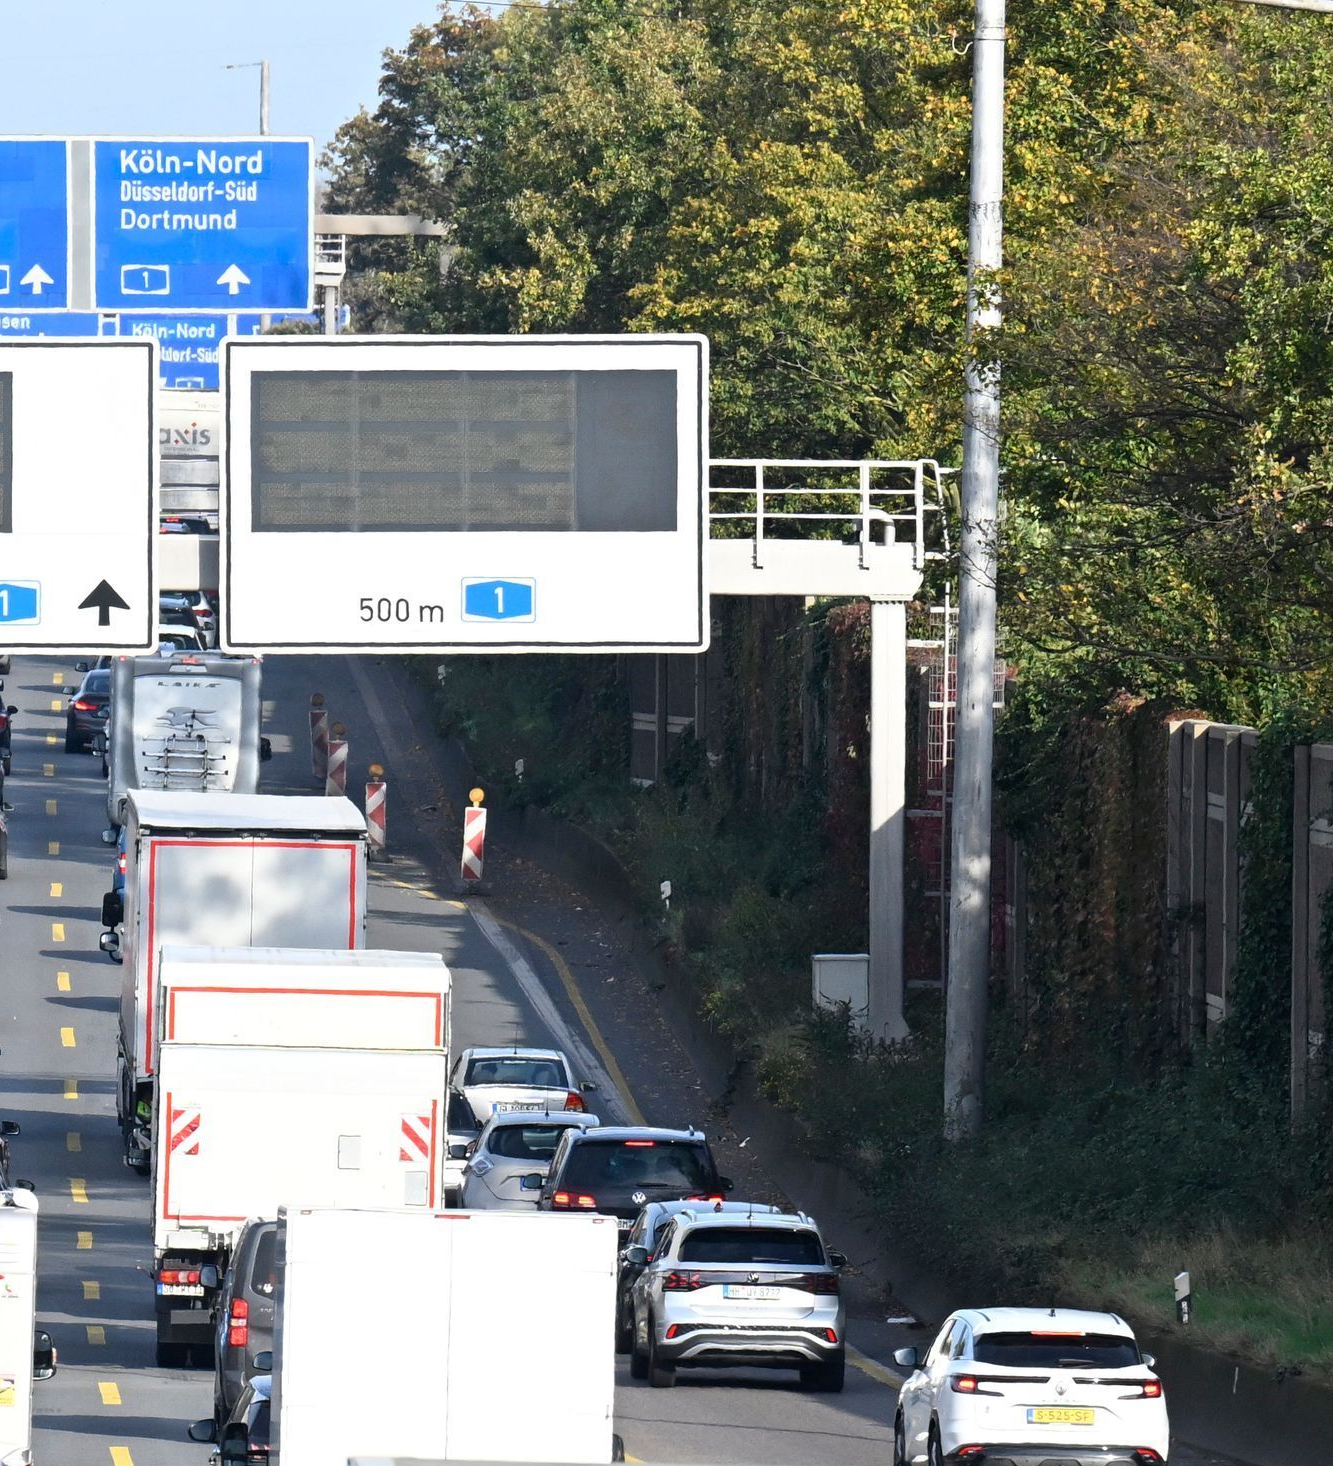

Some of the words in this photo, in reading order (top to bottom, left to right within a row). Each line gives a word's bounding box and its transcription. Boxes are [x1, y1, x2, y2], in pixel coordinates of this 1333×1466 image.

[119, 148, 263, 175] Köln-Nord
[120, 180, 258, 203] Düsseldorf-Süd
[120, 208, 238, 231] Dortmund
[142, 271, 149, 288] 1
[0, 590, 9, 615] 1
[360, 598, 410, 622] 500
[419, 605, 444, 623] m
[494, 587, 503, 613] 1
[1036, 1410, 1089, 1421] S-525-SF
